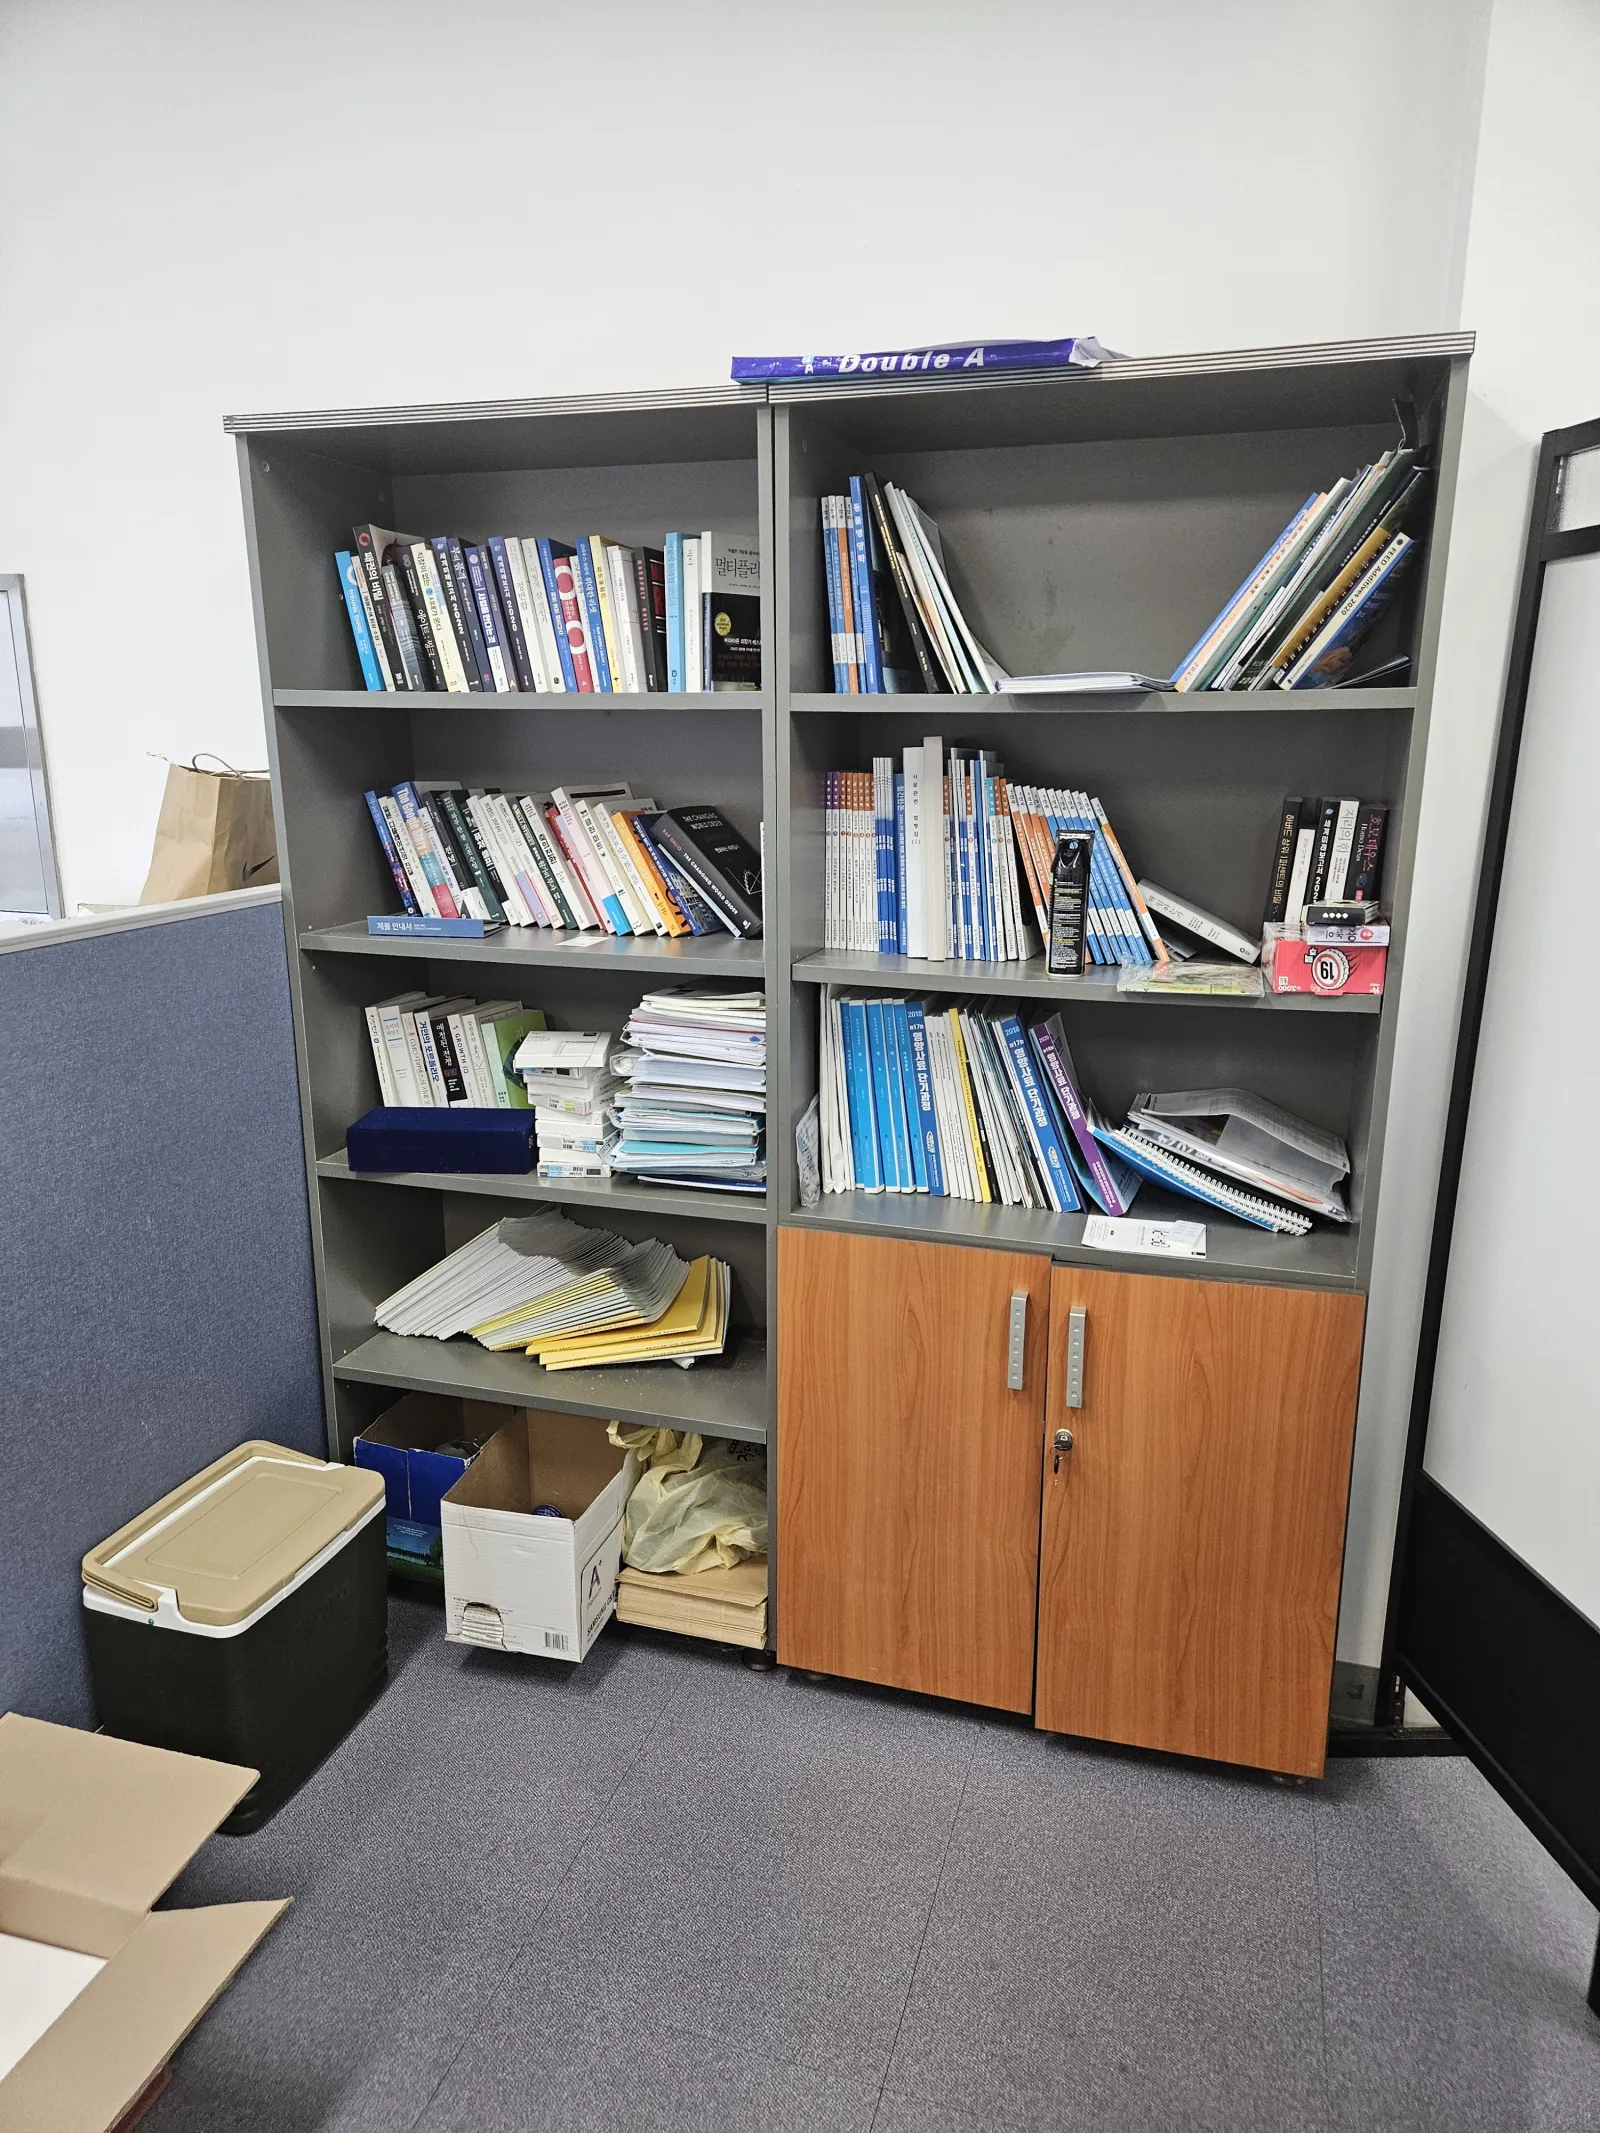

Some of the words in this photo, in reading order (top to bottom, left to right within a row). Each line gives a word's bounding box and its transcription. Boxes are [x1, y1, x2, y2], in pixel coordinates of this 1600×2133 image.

[838, 352, 949, 373] Double
[963, 348, 985, 367] A
[1380, 546, 1396, 566] FEED
[362, 550, 378, 580] 패권의
[370, 580, 384, 601] 비밀
[584, 576, 594, 599] 위대한
[1354, 564, 1382, 599] Additives
[427, 595, 439, 616] 시대가
[433, 616, 442, 631] 온다
[451, 602, 464, 634] 2022
[506, 599, 517, 632] 2020
[587, 599, 597, 614] 리셋
[1340, 597, 1356, 616] 2020
[396, 787, 412, 804] The
[400, 800, 422, 830] Google
[483, 801, 495, 818] 트렌드
[490, 817, 502, 833] 코리아
[498, 802, 509, 818] 트렌드
[505, 817, 516, 834] 코리아
[1337, 807, 1355, 841] 지리의
[1367, 814, 1381, 838] 호모
[410, 827, 430, 850] Story
[1360, 823, 1368, 842] Homo
[1279, 837, 1290, 855] 상위
[1335, 841, 1349, 853] 힘
[1356, 843, 1365, 861] Deus
[1361, 837, 1378, 872] 데우스
[682, 851, 692, 862] THE
[689, 860, 712, 886] CHANGING
[710, 884, 725, 901] WORLD
[723, 898, 738, 916] ORDER
[1272, 888, 1282, 904] 비밀
[377, 922, 391, 931] 제품
[391, 922, 412, 931] 안내서
[1320, 961, 1335, 980] 19
[908, 1010, 923, 1018] 2018
[418, 1020, 431, 1043] 거인의
[1005, 1026, 1020, 1036] 2018
[409, 1037, 418, 1055] GMO
[454, 1032, 466, 1064] GROWTH
[913, 1031, 927, 1071] 영양사료
[424, 1044, 441, 1083] 포트폴리오
[917, 1072, 931, 1111] 단기과정
[1014, 1047, 1035, 1088] 영양사료
[1027, 1088, 1048, 1127] 단기과정
[1047, 1053, 1067, 1087] 영양사료
[1061, 1086, 1081, 1120] 단기과정
[587, 1603, 607, 1636] SAMSUNG
